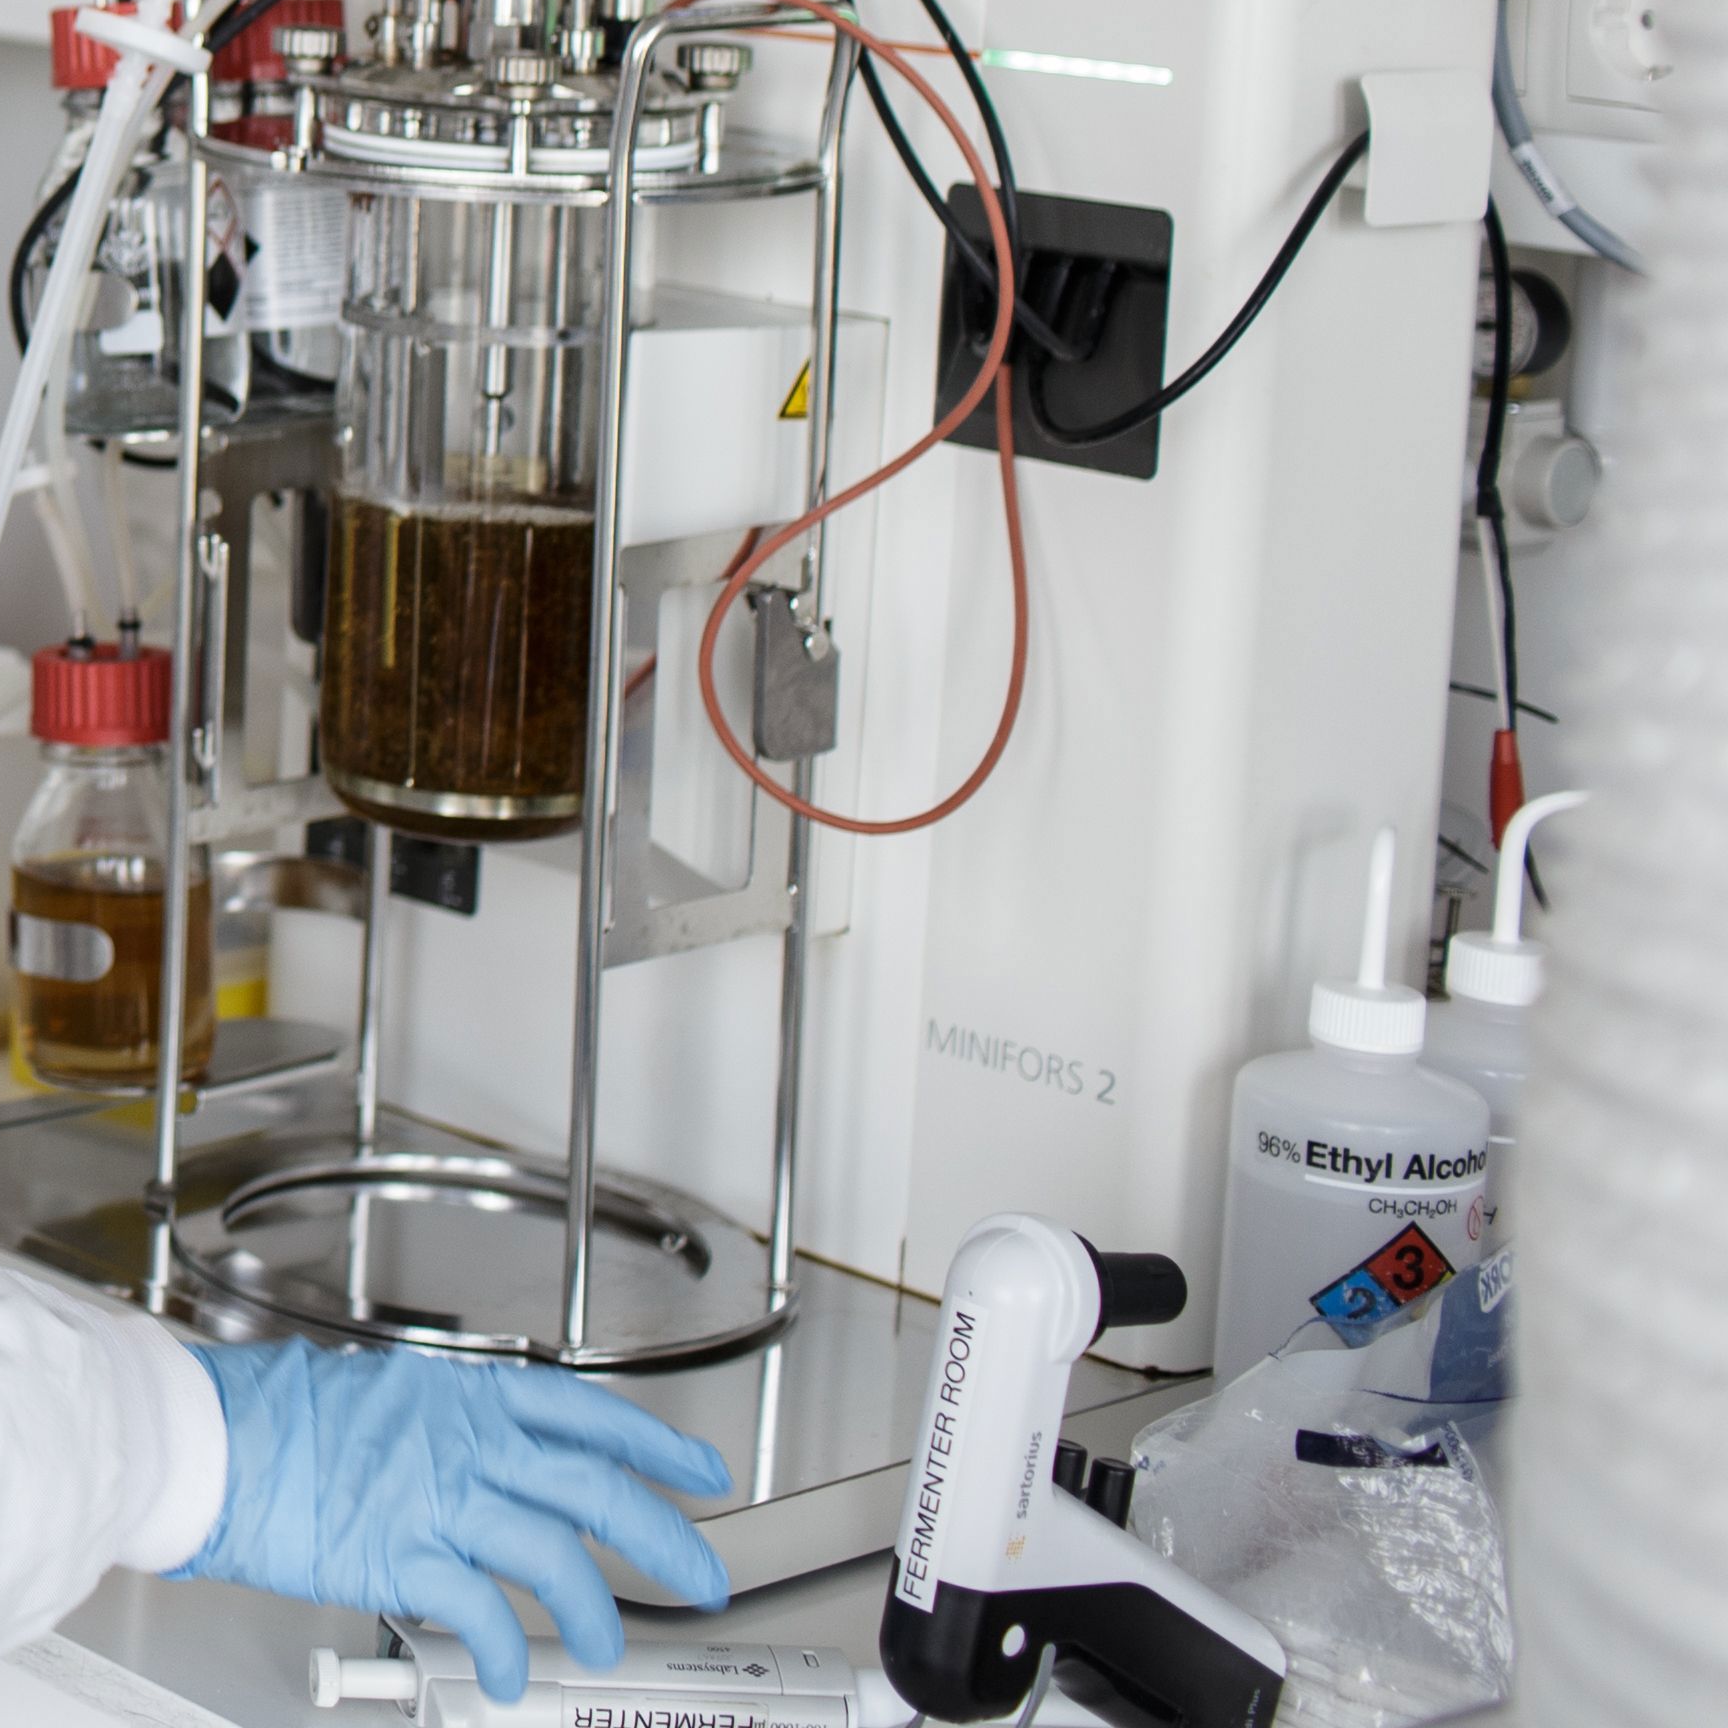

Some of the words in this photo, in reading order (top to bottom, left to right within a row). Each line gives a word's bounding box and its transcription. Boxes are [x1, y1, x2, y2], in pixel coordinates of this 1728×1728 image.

[927, 1018, 1084, 1096] MINIFORS
[1095, 1069, 1117, 1106] 2
[1257, 1130, 1301, 1164] 96%
[1305, 1139, 1393, 1184] Ethyl
[1394, 1244, 1424, 1291] 3
[903, 1411, 957, 1600] FERMENTER
[940, 1310, 976, 1406] ROOM
[1016, 1430, 1043, 1520] sartorius
[666, 1661, 739, 1676] Labsystems
[1247, 1688, 1261, 1715] Plus
